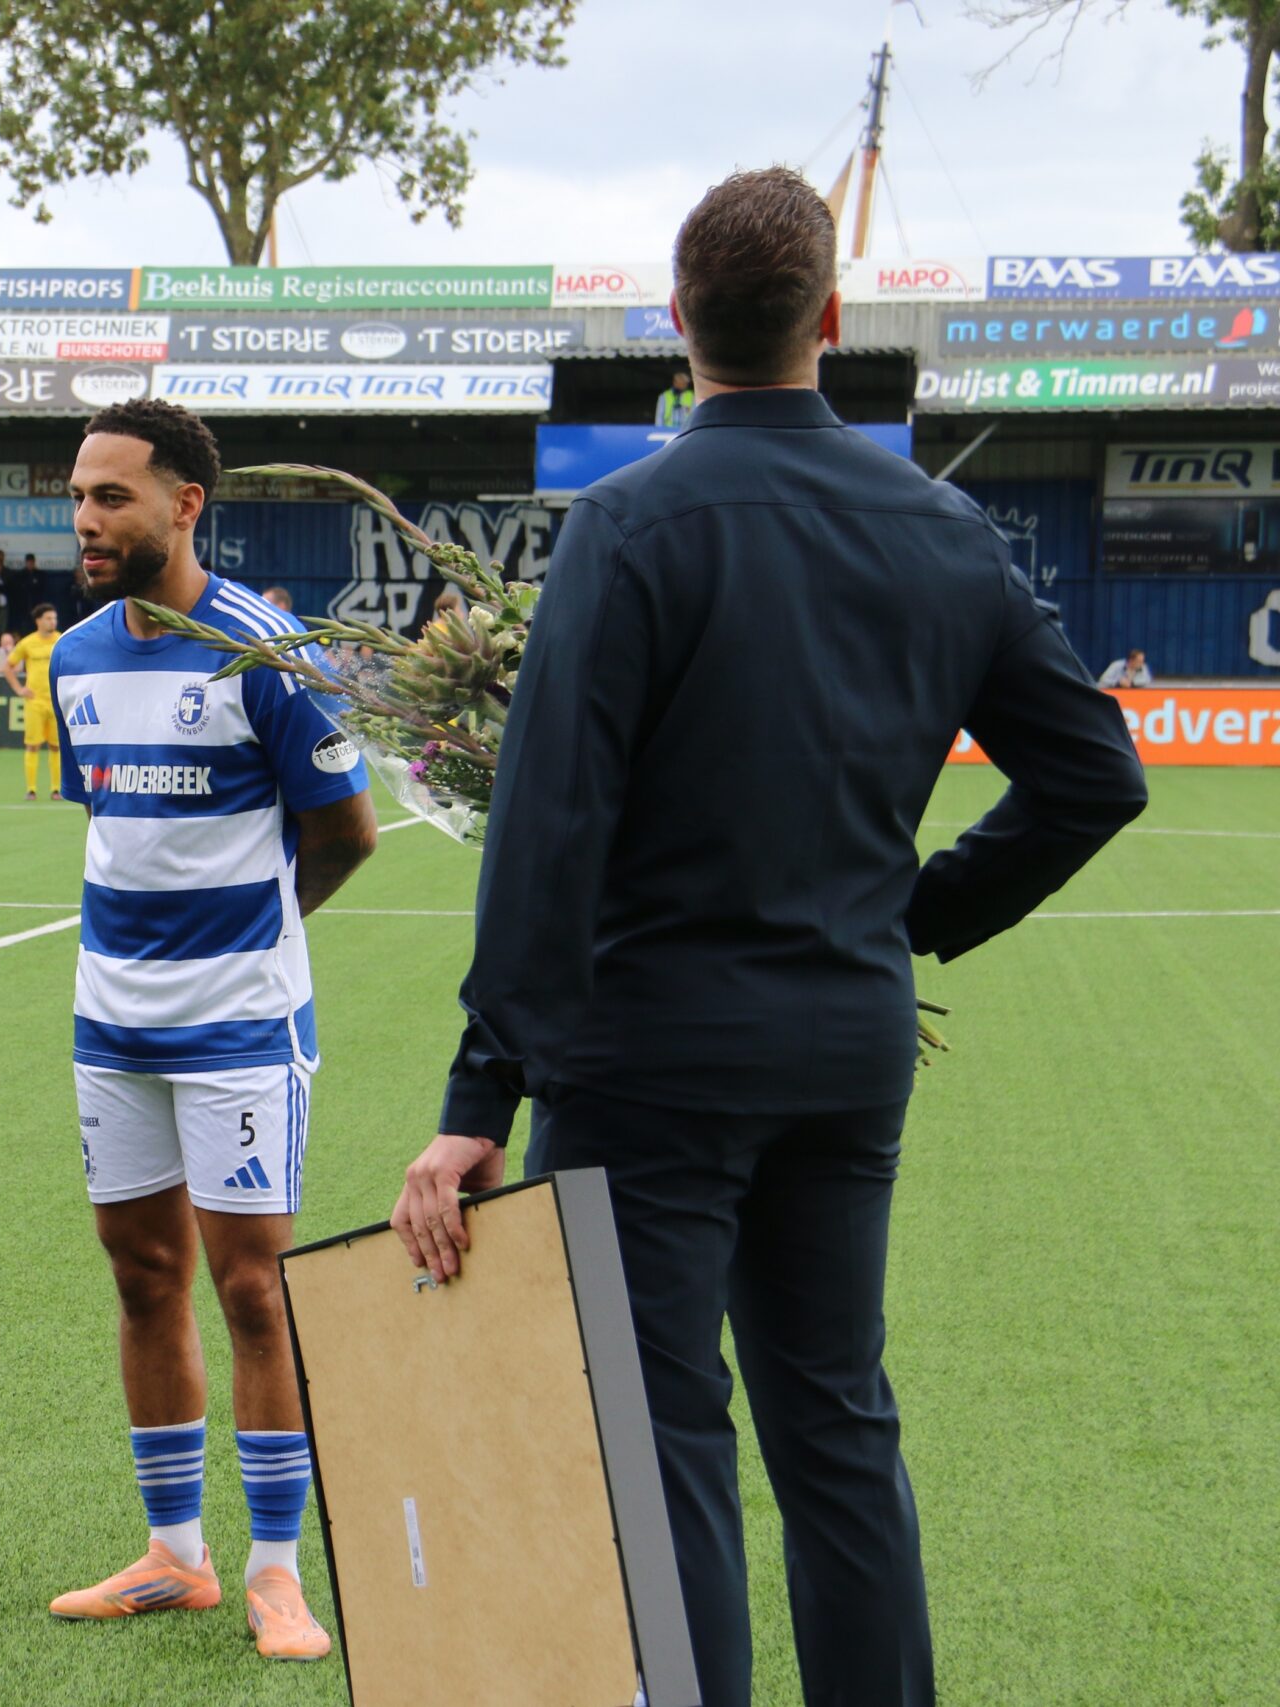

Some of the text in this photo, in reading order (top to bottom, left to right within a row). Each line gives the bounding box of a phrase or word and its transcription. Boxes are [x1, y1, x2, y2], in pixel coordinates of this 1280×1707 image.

[145, 272, 549, 302] Beekhuis Registeraccountants
[556, 274, 624, 292] HAPO
[877, 269, 950, 288] HAPO
[992, 257, 1122, 288] BAAS
[1149, 256, 1280, 288] BAAS
[946, 311, 1218, 342] meerwaerde
[60, 343, 163, 358] BUNSCHOTEN
[913, 365, 1217, 405] Duijst & Timmer.nl
[239, 1112, 255, 1147] 5
